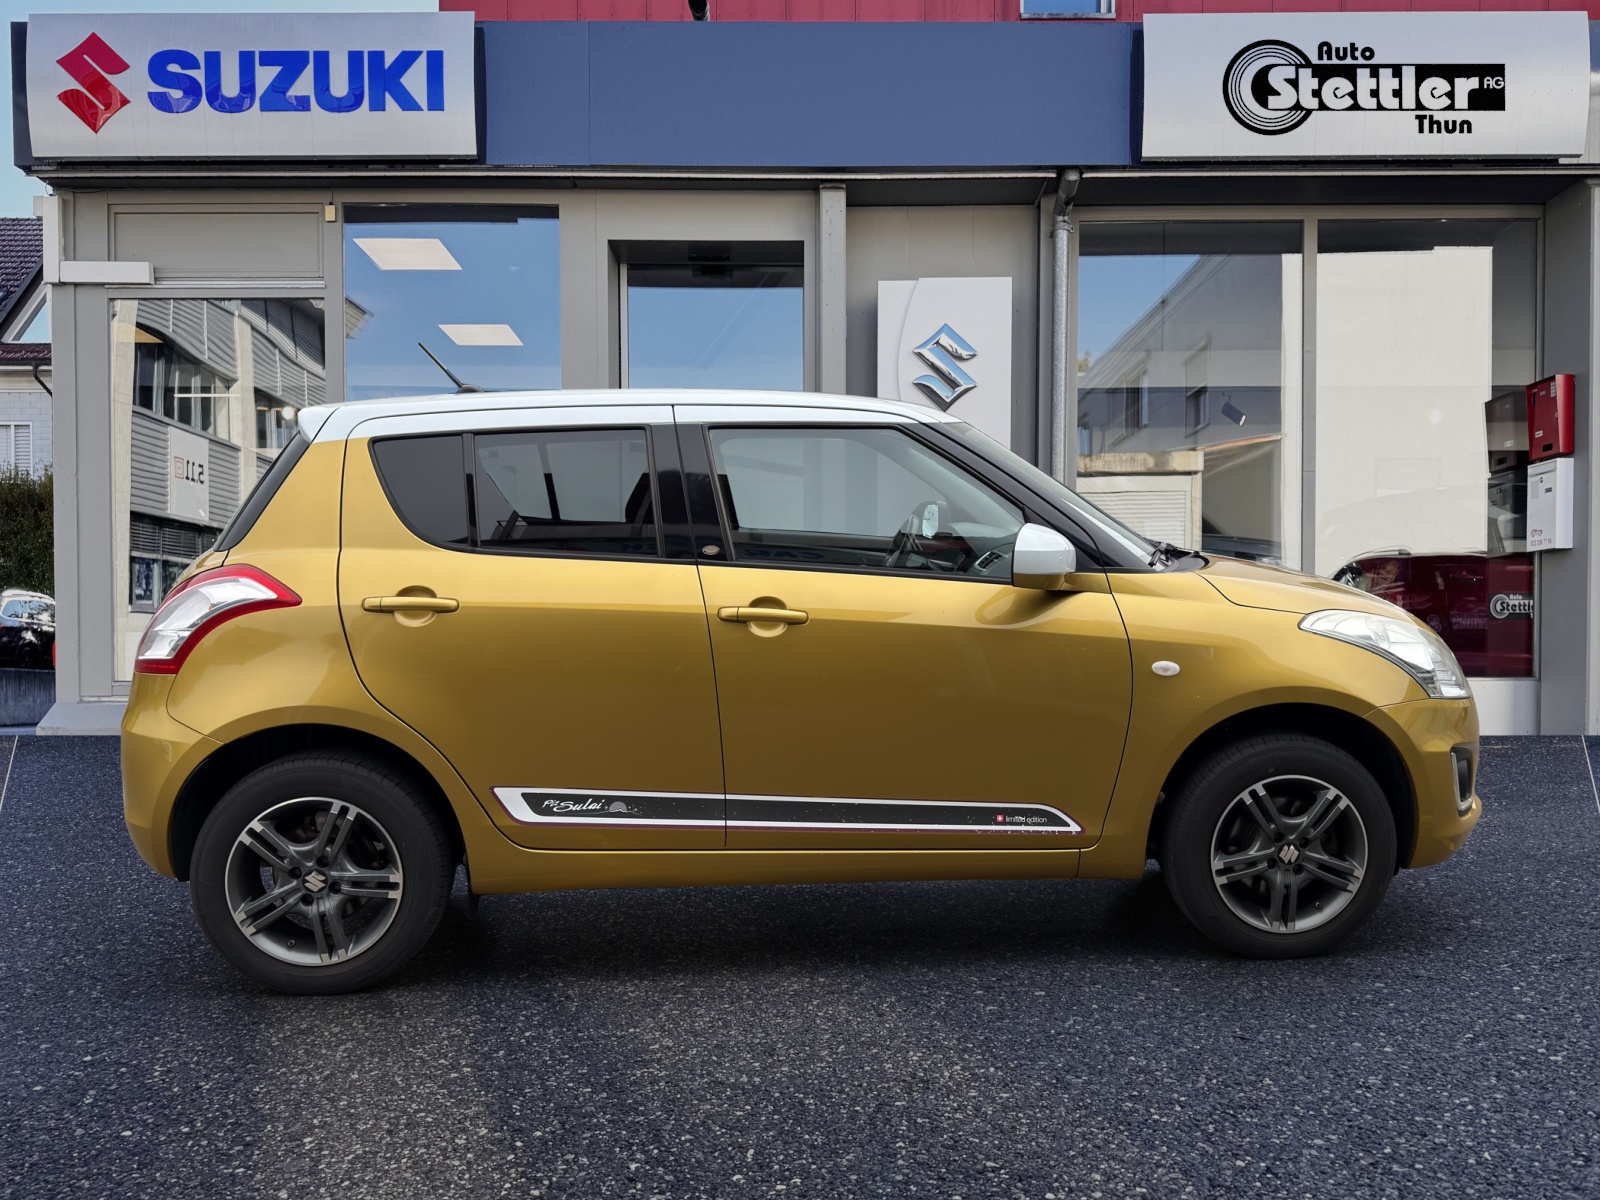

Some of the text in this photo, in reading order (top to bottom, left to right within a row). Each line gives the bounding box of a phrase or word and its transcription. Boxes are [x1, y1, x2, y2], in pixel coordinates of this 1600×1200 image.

[1317, 41, 1375, 61] Auto
[147, 49, 444, 113] SUZUKI
[1267, 65, 1505, 110] Stettler AG
[1415, 115, 1472, 134] Thun
[542, 798, 605, 812] Piz Sulai
